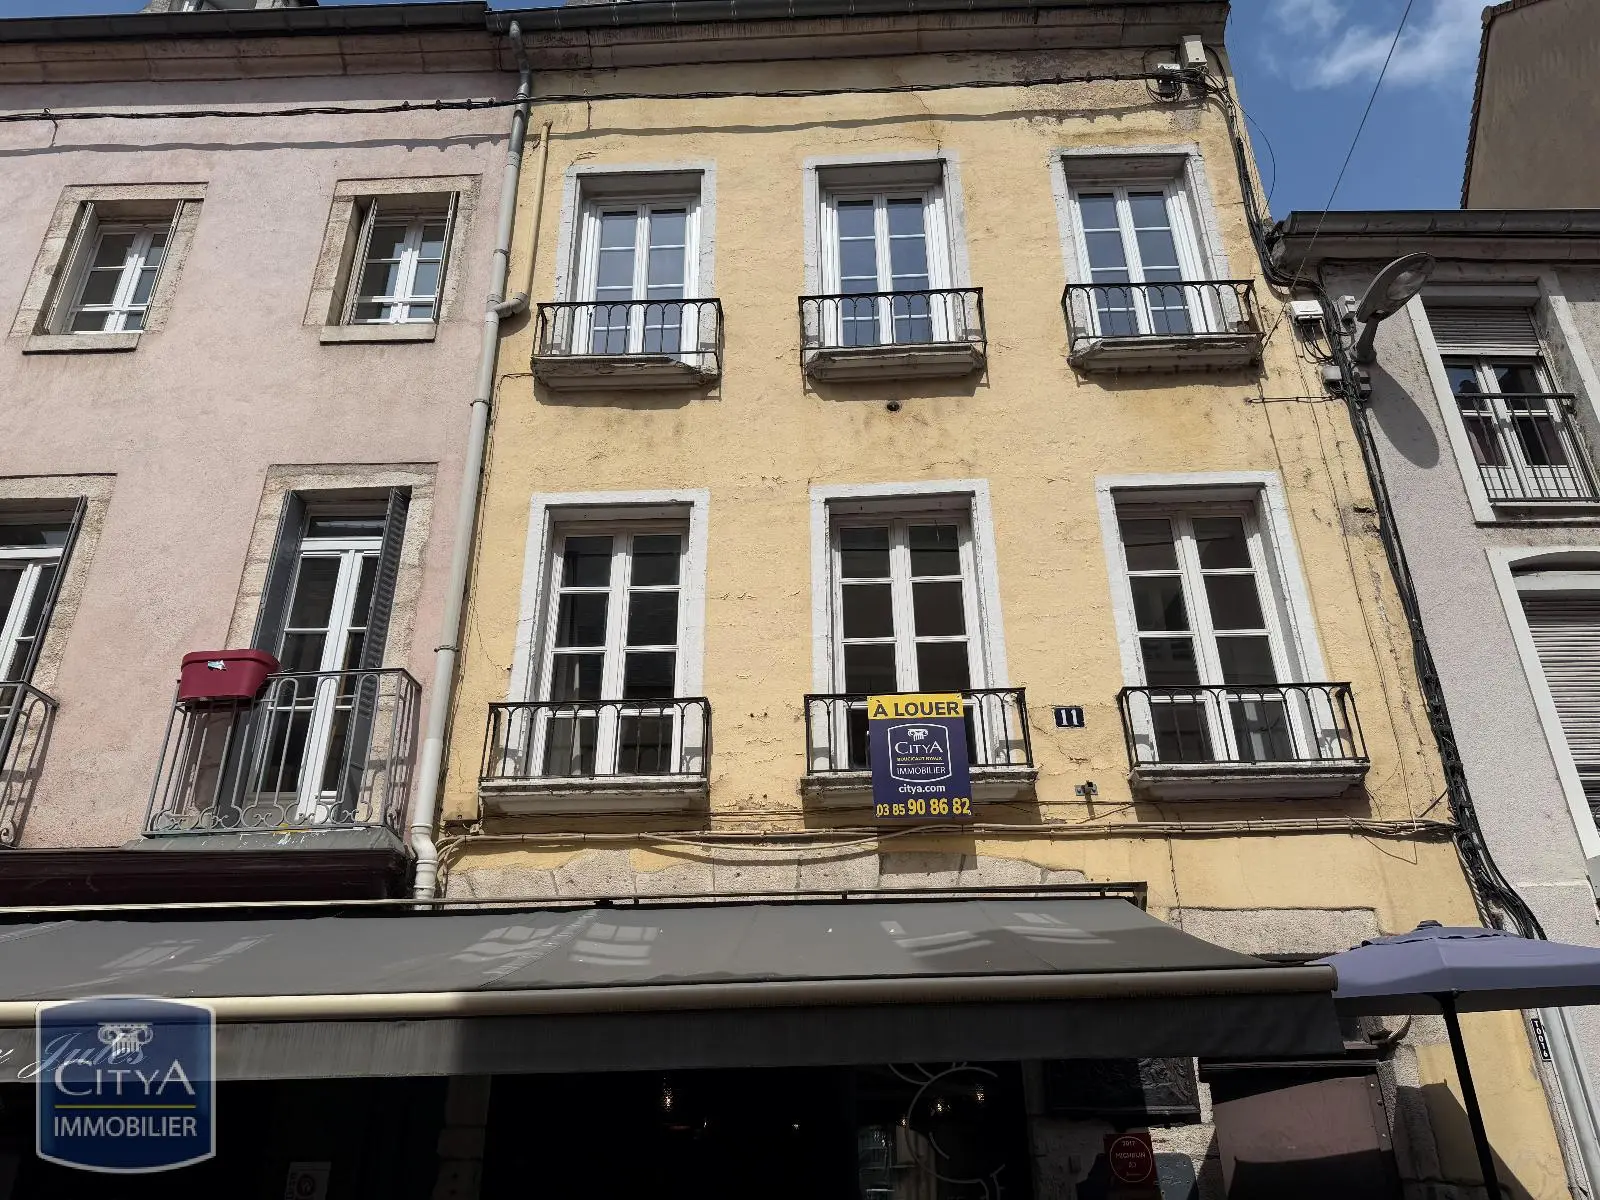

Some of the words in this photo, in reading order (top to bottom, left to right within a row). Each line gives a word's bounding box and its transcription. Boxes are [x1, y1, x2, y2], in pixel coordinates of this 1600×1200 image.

[873, 700, 888, 717] À
[894, 701, 960, 716] LOUER
[1060, 708, 1079, 726] 11
[897, 766, 946, 775] IMMOBILIER
[898, 783, 946, 795] citya.com
[876, 804, 890, 816] 03
[892, 803, 905, 815] 85
[907, 799, 926, 815] 90
[930, 798, 949, 815] 86
[952, 797, 971, 814] 82
[17, 1032, 148, 1079] Jules
